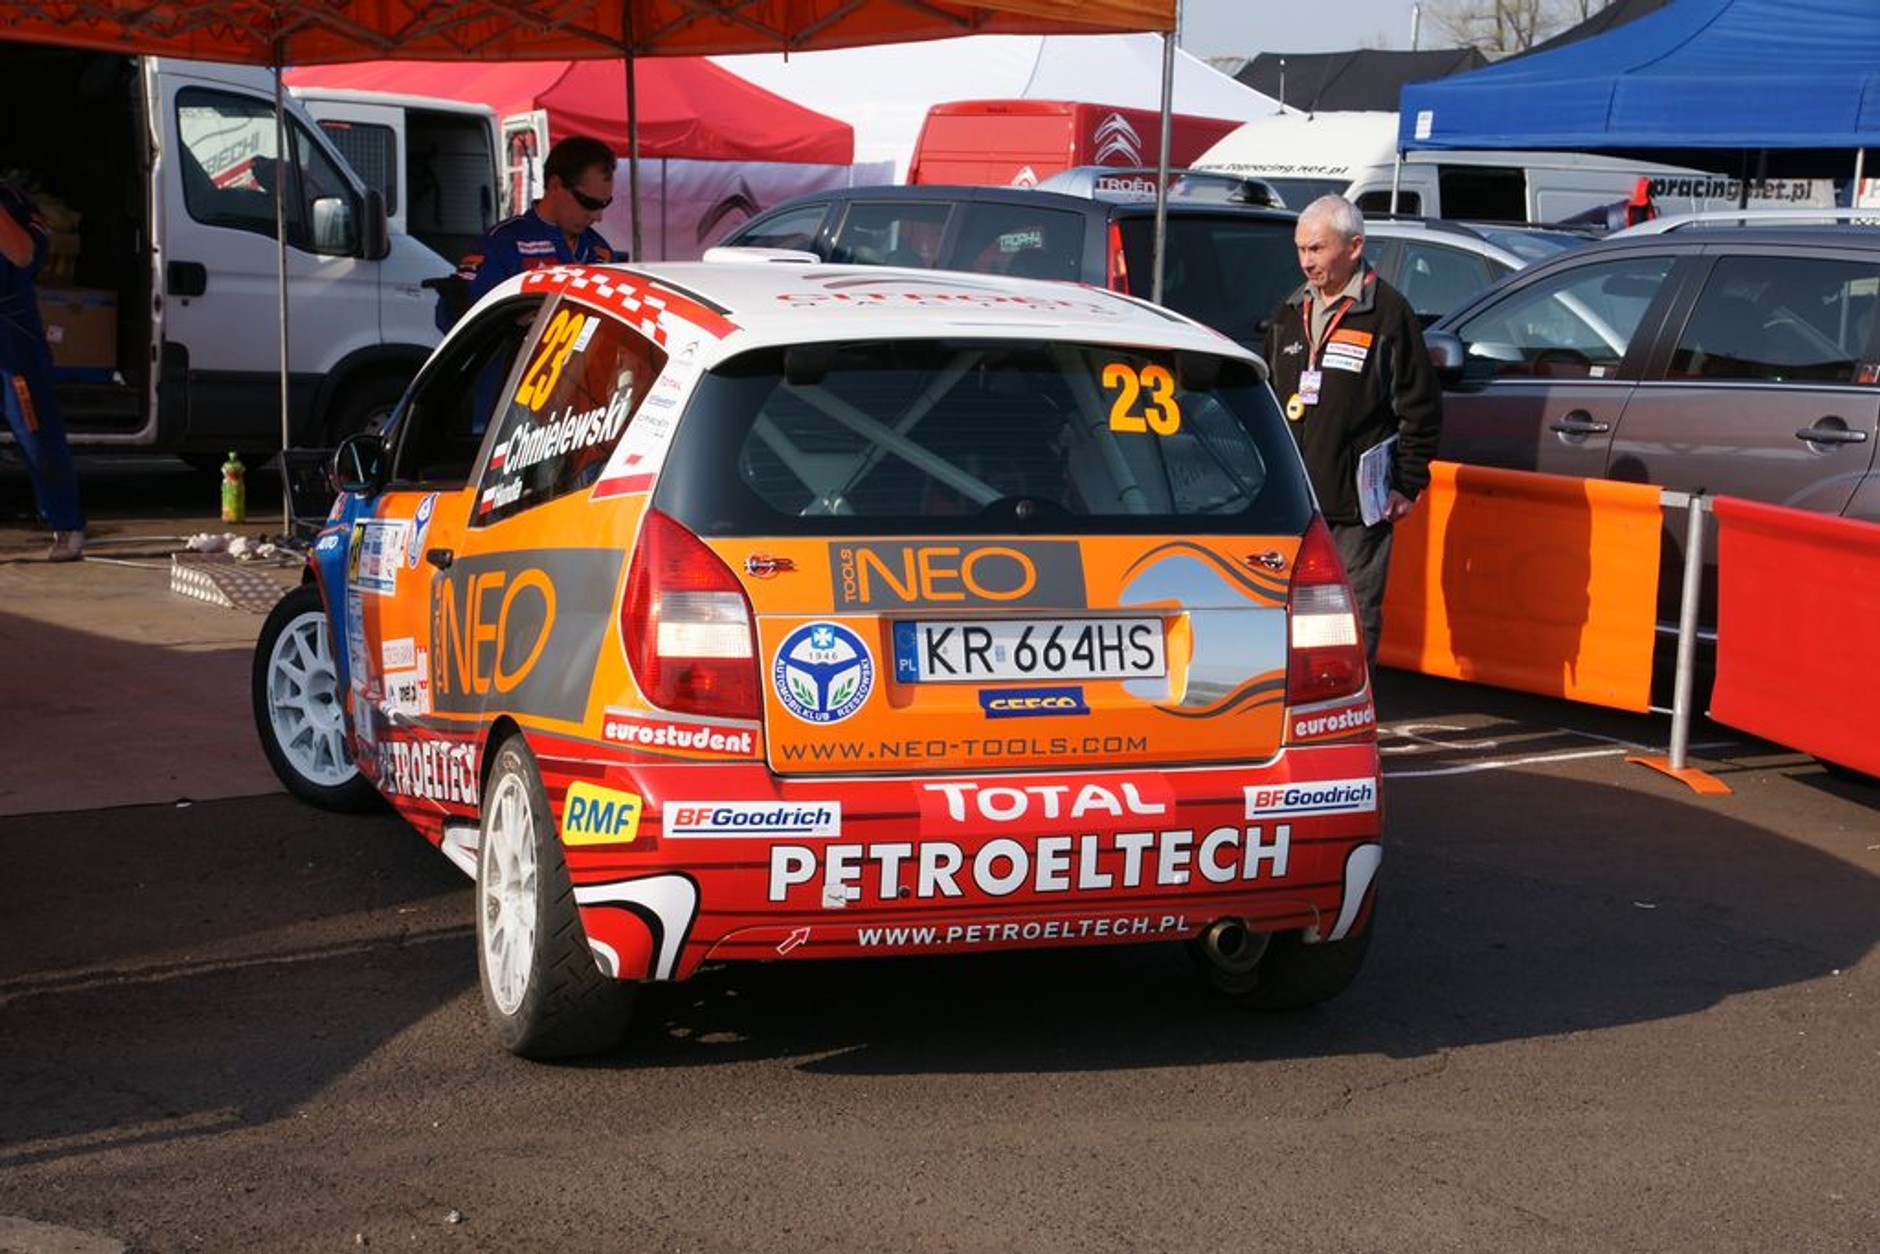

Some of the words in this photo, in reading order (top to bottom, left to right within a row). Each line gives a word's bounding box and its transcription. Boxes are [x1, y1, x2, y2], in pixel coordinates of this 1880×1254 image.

[515, 309, 585, 412] 23
[1103, 362, 1181, 436] 23
[502, 387, 633, 475] Chmielewski
[841, 549, 857, 603] TOOLS
[855, 547, 1037, 603] NEO
[443, 568, 557, 695] NEO
[925, 626, 994, 675] KR
[1013, 624, 1155, 673] 664HS
[808, 652, 838, 661] 1946
[899, 659, 917, 672] PL
[776, 659, 830, 720] AUTOMOBILKLUB
[989, 696, 1077, 710] GEFCO
[604, 721, 752, 753] eurostudent
[781, 734, 1148, 762] WWW.NEO-TOOLS.COM
[566, 796, 634, 835] RMF
[923, 781, 1166, 822] TOTAL
[1254, 783, 1372, 808] BFGoodrich
[674, 808, 832, 827] BFGoodrich
[767, 823, 1292, 903] PETROELTECH
[857, 916, 1190, 946] WWW.PETROELTECH.PL
